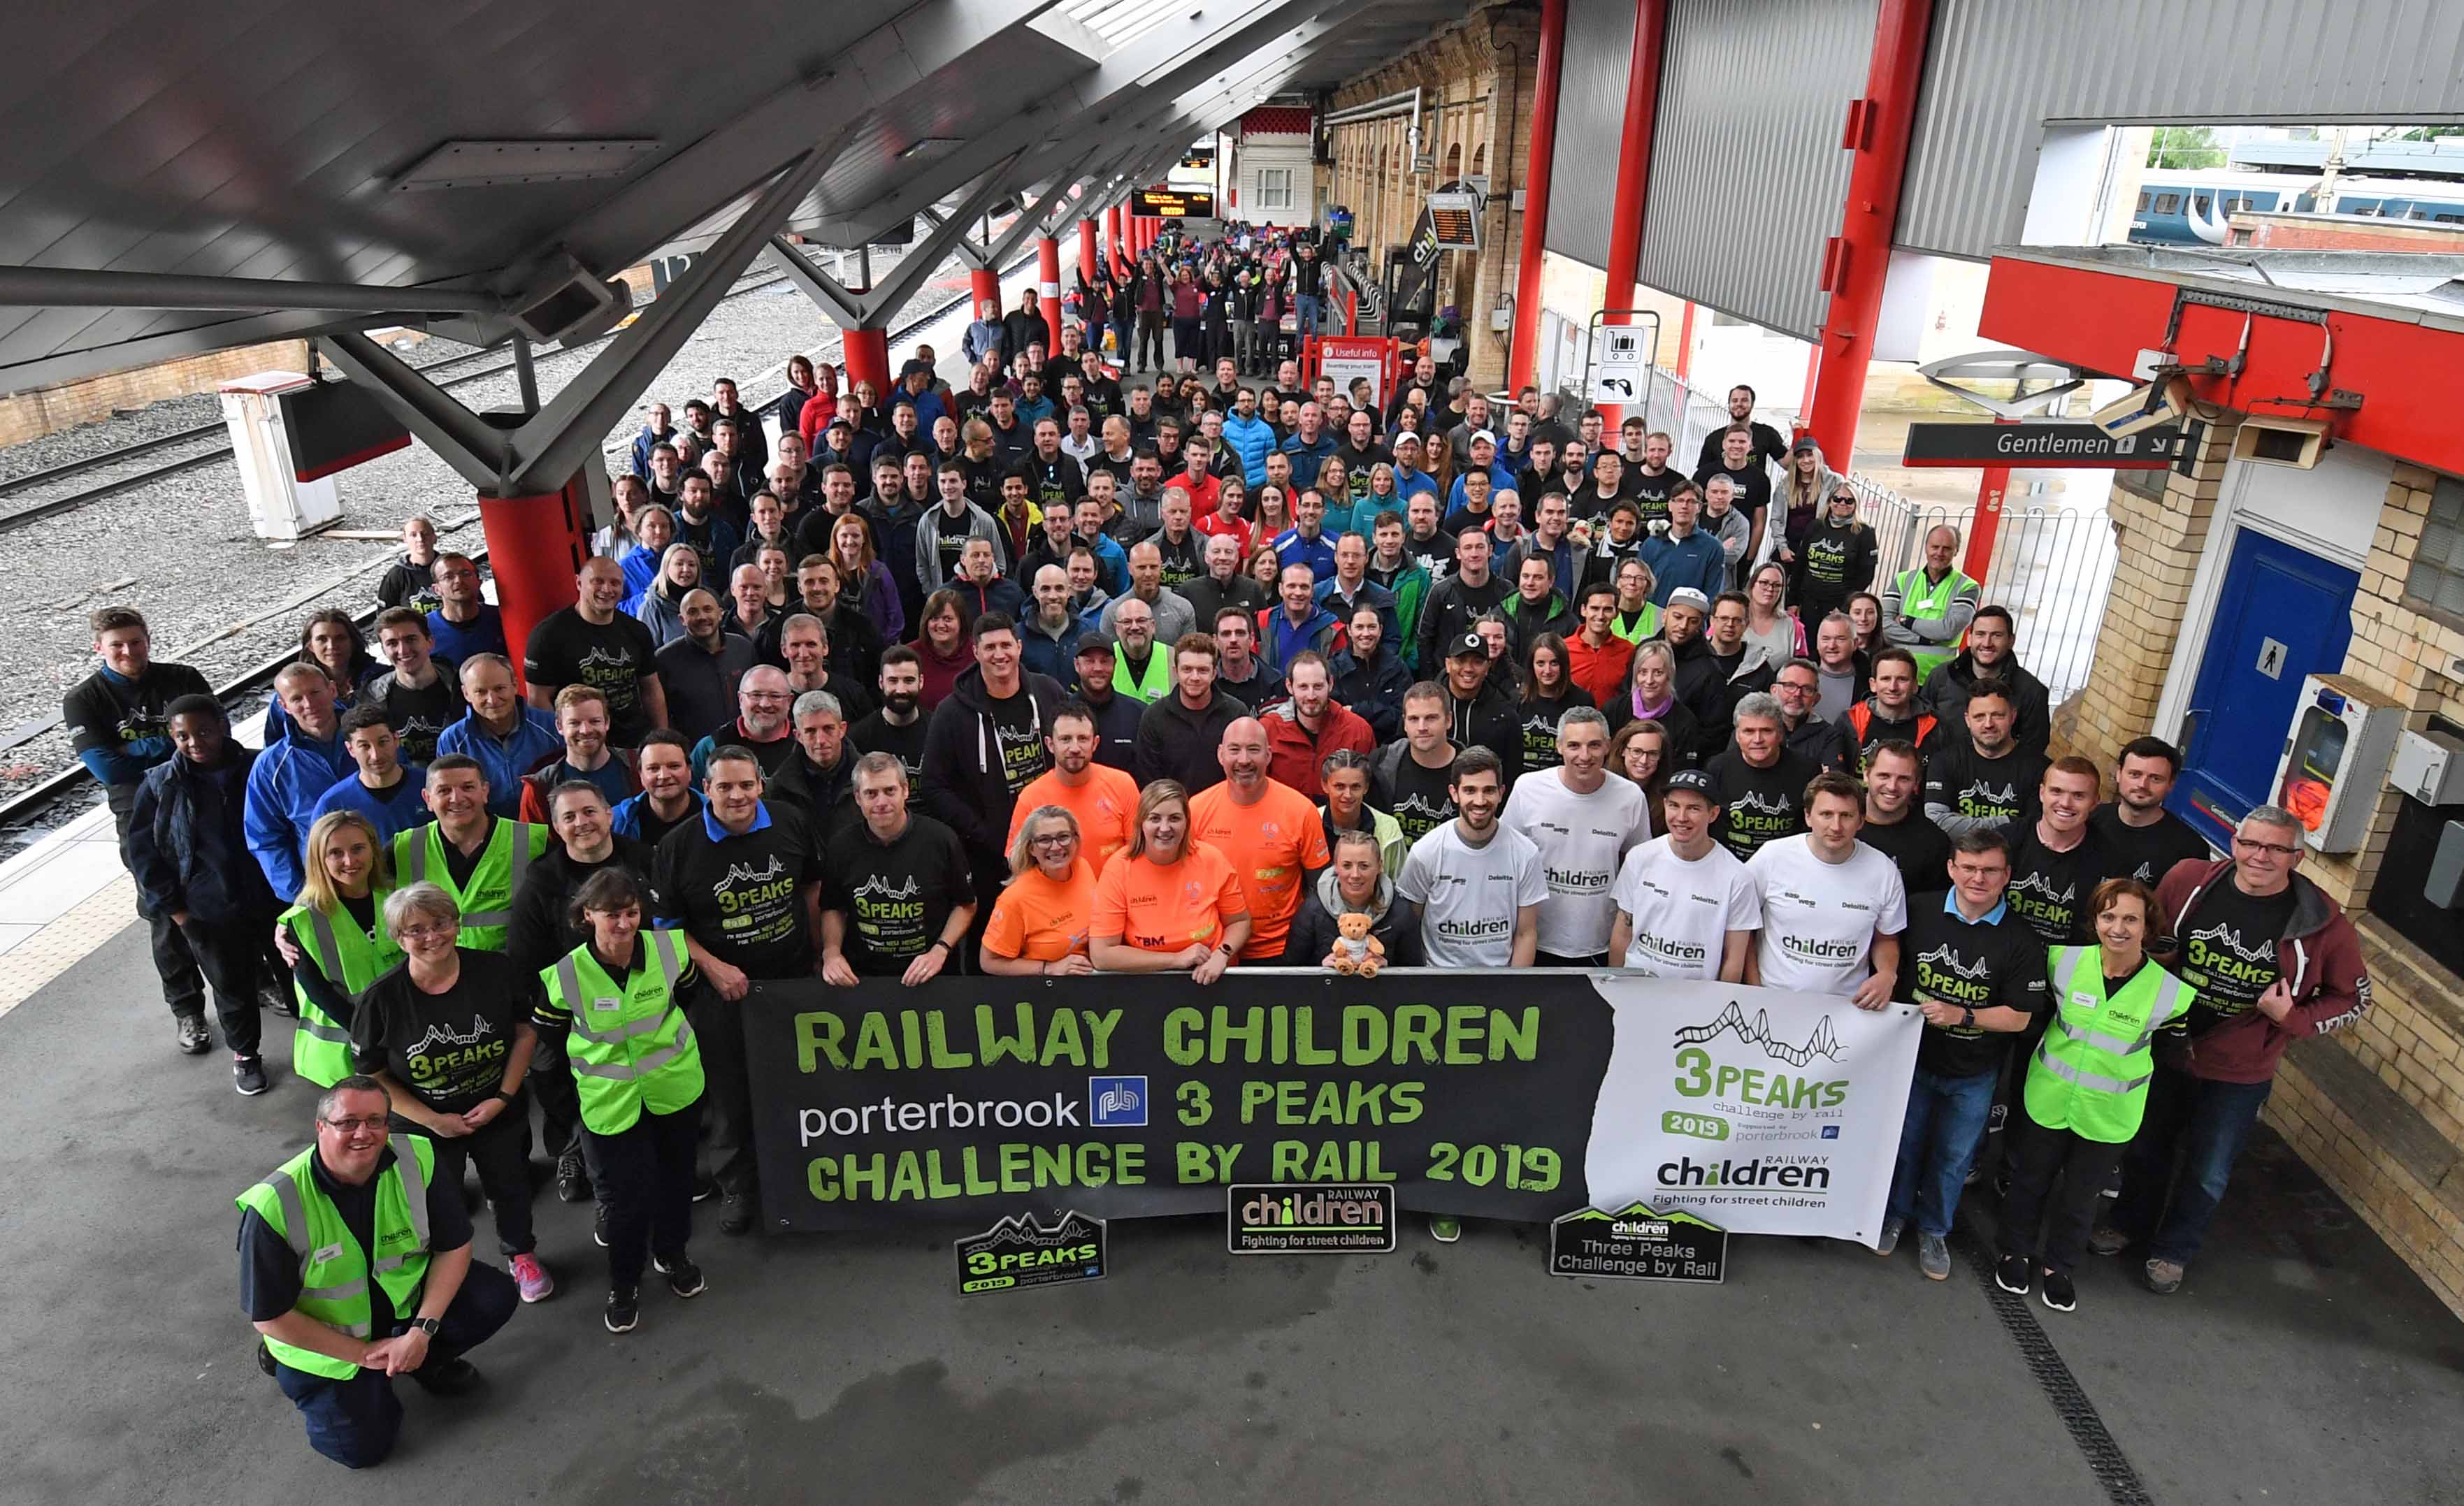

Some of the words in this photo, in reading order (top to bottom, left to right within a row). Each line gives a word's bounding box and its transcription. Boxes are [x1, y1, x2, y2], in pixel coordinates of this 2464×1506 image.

[1414, 226, 1435, 263] chil
[1336, 348, 1360, 357] Useful
[1362, 348, 1377, 358] info
[1997, 433, 2109, 454] Gentlemen
[939, 533, 965, 545] hildre
[1808, 547, 1815, 559] 3
[1815, 551, 1845, 564] PEAKS
[1523, 731, 1532, 748] 3
[1532, 736, 1555, 748] PEA
[1006, 743, 1041, 763] PEAK
[1959, 798, 1974, 817] 3
[1408, 818, 1437, 832] PEA
[1730, 810, 1745, 829] 3
[1745, 816, 1795, 830] PEAKS
[719, 890, 738, 913] 3
[739, 878, 793, 906] PEAKS
[2008, 890, 2023, 913] 3
[856, 897, 871, 918] 3
[871, 902, 924, 918] PEAKS
[1439, 919, 1508, 935] children
[1135, 935, 1165, 947] TBM
[1638, 931, 1706, 959] children
[1782, 935, 1857, 957] children
[2189, 939, 2207, 965] 3
[2206, 953, 2275, 984] PEAKS
[1917, 962, 1931, 987] 3
[1931, 973, 1991, 1001] PEAKS
[634, 986, 663, 1000] children
[2210, 985, 2254, 999] porterbrook
[2109, 1009, 2140, 1024] children
[794, 1001, 1123, 1073] RAILWAY
[1163, 1004, 1540, 1066] CHILDREN
[410, 1055, 433, 1080] 3
[434, 1040, 505, 1073] PEAKS
[1675, 1048, 1712, 1097] 3
[1715, 1065, 1850, 1109] PEAKS
[1176, 1080, 1213, 1127] 3
[1241, 1080, 1425, 1126] PEAKS
[1713, 1102, 1784, 1121] challenge
[1792, 1111, 1808, 1121] by
[1815, 1109, 1843, 1118] rail
[799, 1092, 1081, 1147] porterbrook
[1671, 1115, 1719, 1137] 2019
[1736, 1129, 1817, 1143] porterbrook
[1765, 1155, 1829, 1165] RAILWAY
[807, 1142, 1146, 1201] CHALLENGE
[1176, 1142, 1243, 1185] BY
[1272, 1141, 1397, 1182] RAIL
[1426, 1142, 1561, 1192] 2019
[1657, 1157, 1830, 1188] children
[1328, 1189, 1379, 1200] RAILWAY
[1653, 1194, 1706, 1206] Fighting
[1710, 1194, 1728, 1204] for
[1731, 1196, 1768, 1205] street
[1772, 1195, 1826, 1208] children
[1242, 1193, 1383, 1225] children
[380, 1228, 412, 1243] children
[1612, 1222, 1669, 1236] children
[1241, 1236, 1287, 1248] Fighting
[1289, 1235, 1304, 1245] for
[1306, 1235, 1339, 1246] street
[1339, 1234, 1385, 1245] children
[1582, 1240, 1633, 1255] Three
[1641, 1243, 1695, 1259] Peaks
[967, 1252, 997, 1275] 3
[1000, 1244, 1097, 1270] PEAKS
[1558, 1255, 1648, 1275] Challenge
[1655, 1259, 1676, 1277] by
[1684, 1261, 1717, 1277] Rail
[970, 1278, 1007, 1289] 2019
[1020, 1271, 1084, 1287] porterbrook
